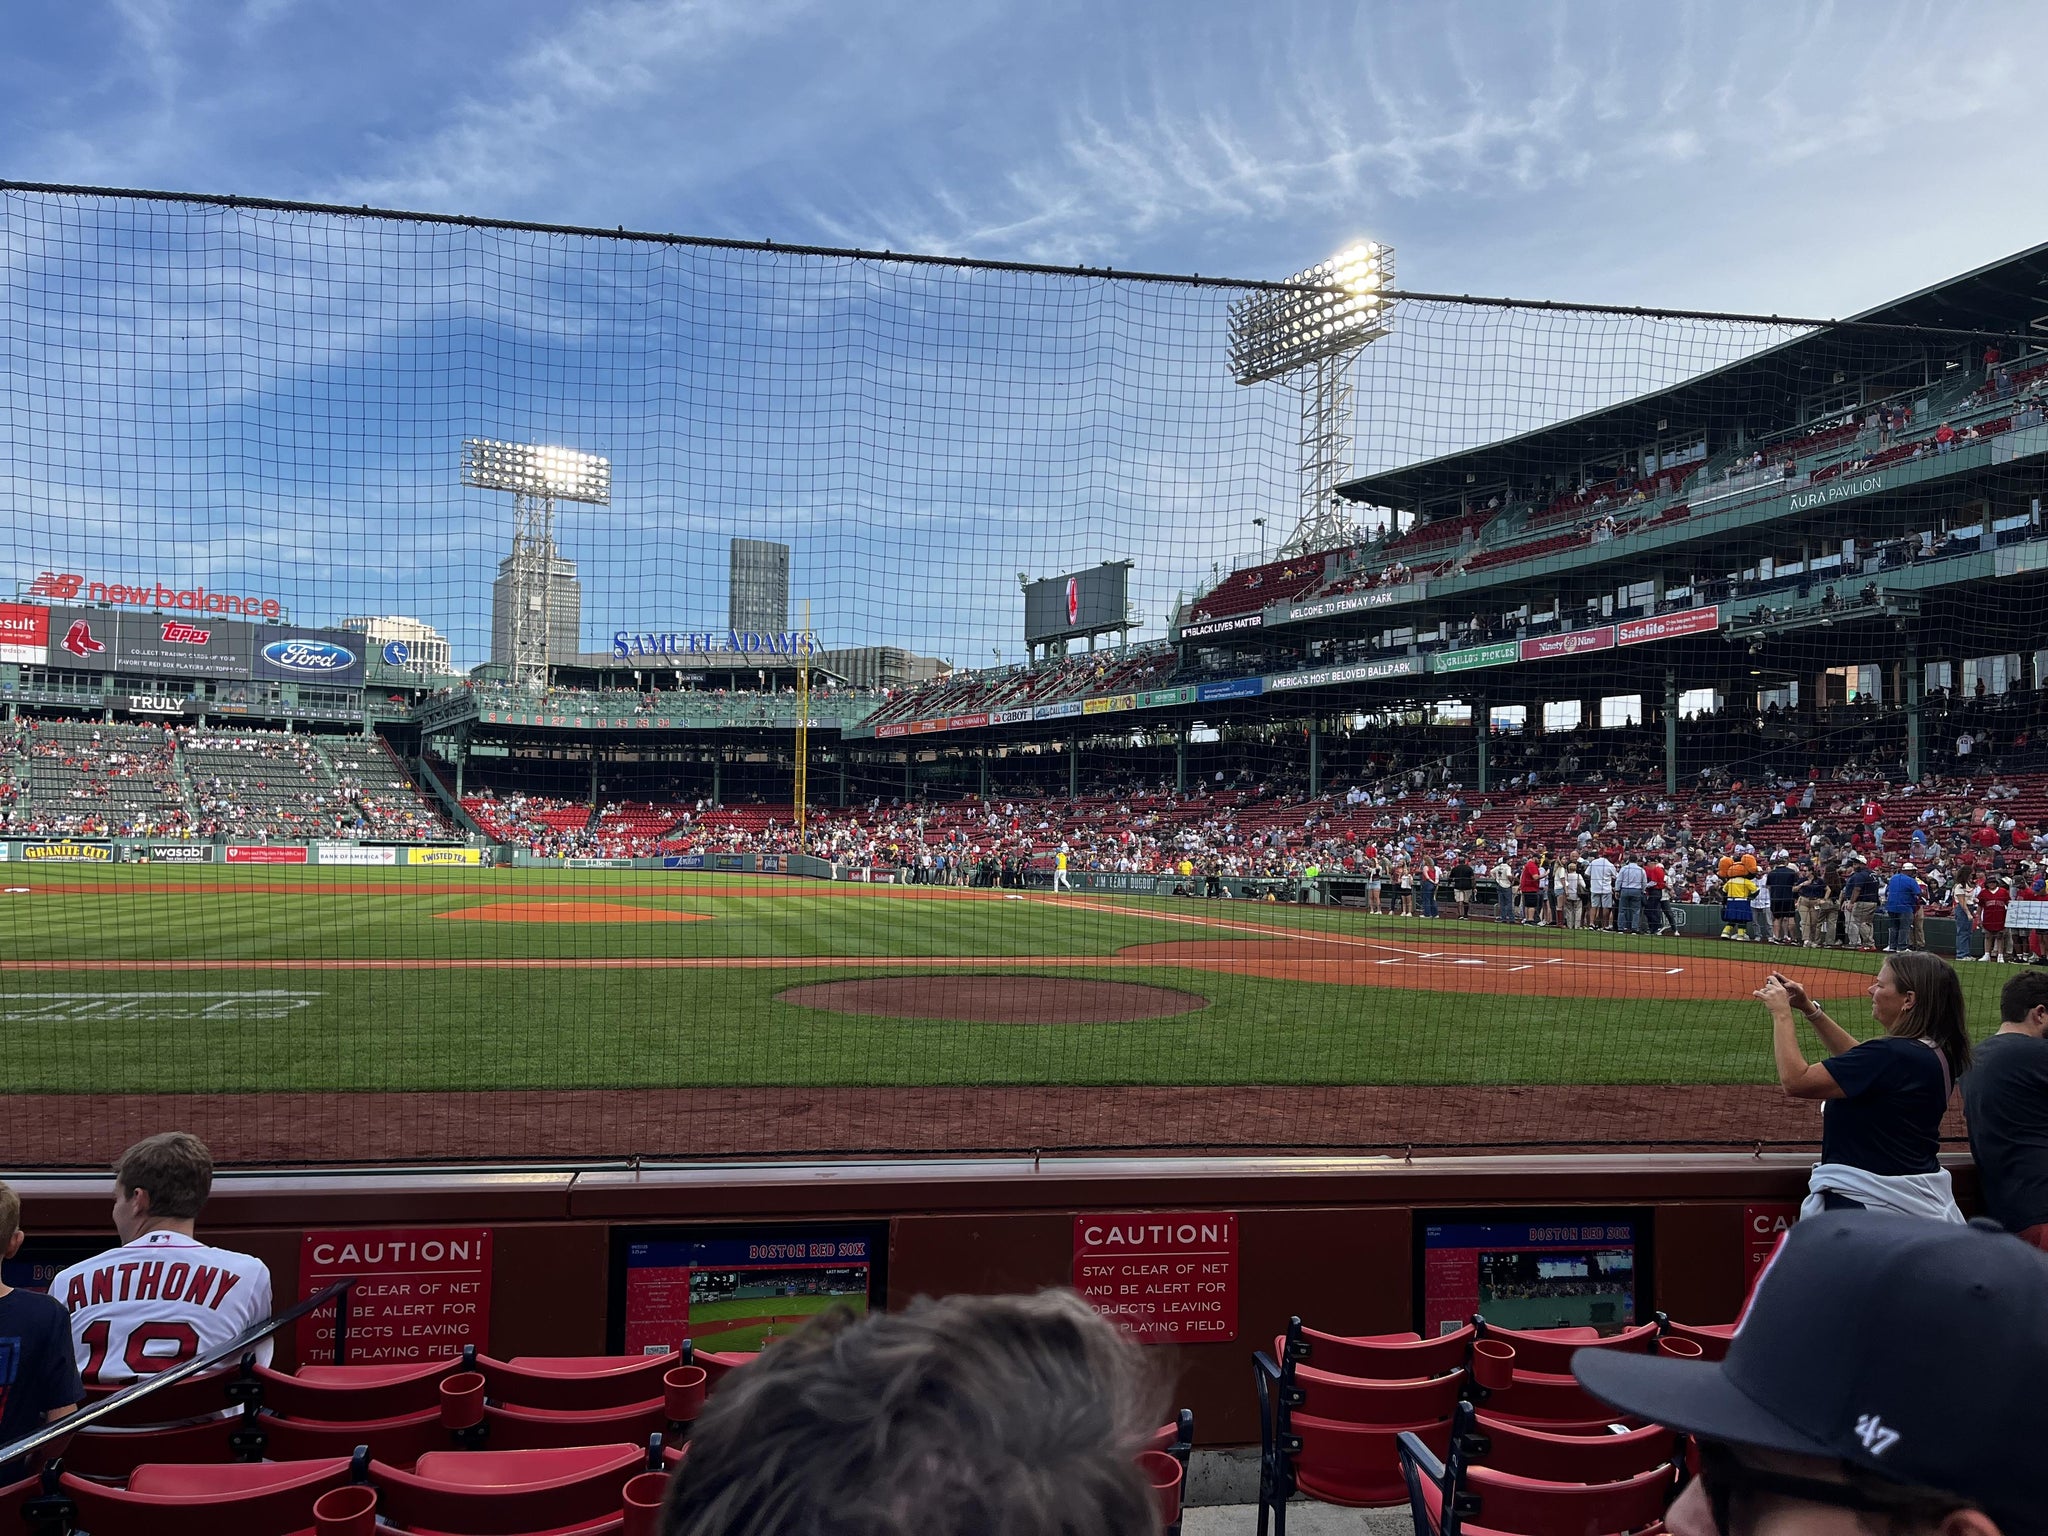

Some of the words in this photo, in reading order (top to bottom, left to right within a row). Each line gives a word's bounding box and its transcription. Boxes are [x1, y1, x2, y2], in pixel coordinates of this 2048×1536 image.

[1829, 477, 1881, 500] PAVILION
[89, 582, 151, 606] new
[156, 583, 281, 618] balance
[1290, 605, 1323, 620] WELCOME
[1325, 603, 1335, 614] TO
[1336, 596, 1369, 612] FENWAY
[1371, 592, 1393, 605] PARK
[1191, 625, 1214, 636] BLACK
[1214, 621, 1234, 633] LIVES
[1234, 616, 1262, 629] MATTER
[1619, 623, 1665, 640] Safelite
[613, 631, 720, 659] SAMUEL
[723, 628, 816, 658] ADAMS
[1539, 641, 1563, 652] Ninety
[1577, 636, 1596, 646] Nine
[281, 644, 337, 667] Ford
[1447, 654, 1479, 668] GRILLO'S
[1481, 647, 1515, 661] PICKLES
[119, 659, 147, 667] FAVORITE
[176, 662, 204, 670] PLAYERS
[1272, 674, 1309, 688] AMERICA'S
[1310, 672, 1330, 684] MOST
[1332, 668, 1366, 681] BELOVED
[1368, 662, 1411, 678] BALLPARK
[129, 696, 184, 711] TRULY
[505, 713, 513, 723] 4
[552, 716, 567, 727] 27
[614, 719, 628, 728] 45
[657, 718, 670, 728] 34
[679, 719, 690, 728] 42
[25, 845, 81, 859] GRANITE
[83, 845, 110, 860] CITY
[155, 846, 204, 858] wasabi
[422, 853, 453, 862] TWISTED
[454, 854, 466, 863] TEA
[1130, 877, 1154, 889] DUGOUT
[1084, 1224, 1228, 1245] CAUTION!
[1529, 1227, 1578, 1241] BOSTON
[1582, 1227, 1604, 1240] RED
[1607, 1227, 1630, 1239] SOX
[313, 1241, 481, 1264] CAUTION!
[749, 1244, 806, 1259] BOSTON
[809, 1243, 836, 1257] RED
[838, 1242, 866, 1256] SOX
[1082, 1265, 1115, 1276] STAY
[1121, 1265, 1169, 1276] CLEAR
[1176, 1264, 1195, 1274] OF
[1202, 1263, 1229, 1274] NET
[67, 1261, 240, 1312] ANTHONY
[355, 1284, 411, 1297] CLEAR
[419, 1283, 442, 1295] OF
[450, 1282, 481, 1294] NET
[1084, 1285, 1113, 1296] AND
[1120, 1284, 1139, 1295] BE
[1145, 1283, 1190, 1294] ALERT
[1197, 1282, 1226, 1293] FOR
[311, 1307, 337, 1319] AN
[353, 1306, 375, 1317] BE
[382, 1304, 435, 1316] ALERT
[443, 1302, 476, 1314] FOR
[1090, 1303, 1156, 1315] OBJECTS
[1163, 1301, 1221, 1313] LEAVING
[402, 1323, 470, 1336] LEAVING
[1120, 1321, 1179, 1333] PLAYING
[1186, 1320, 1226, 1331] FIELD
[310, 1349, 335, 1360] TH
[351, 1346, 419, 1359] PLAYING
[428, 1345, 462, 1356] FIEL
